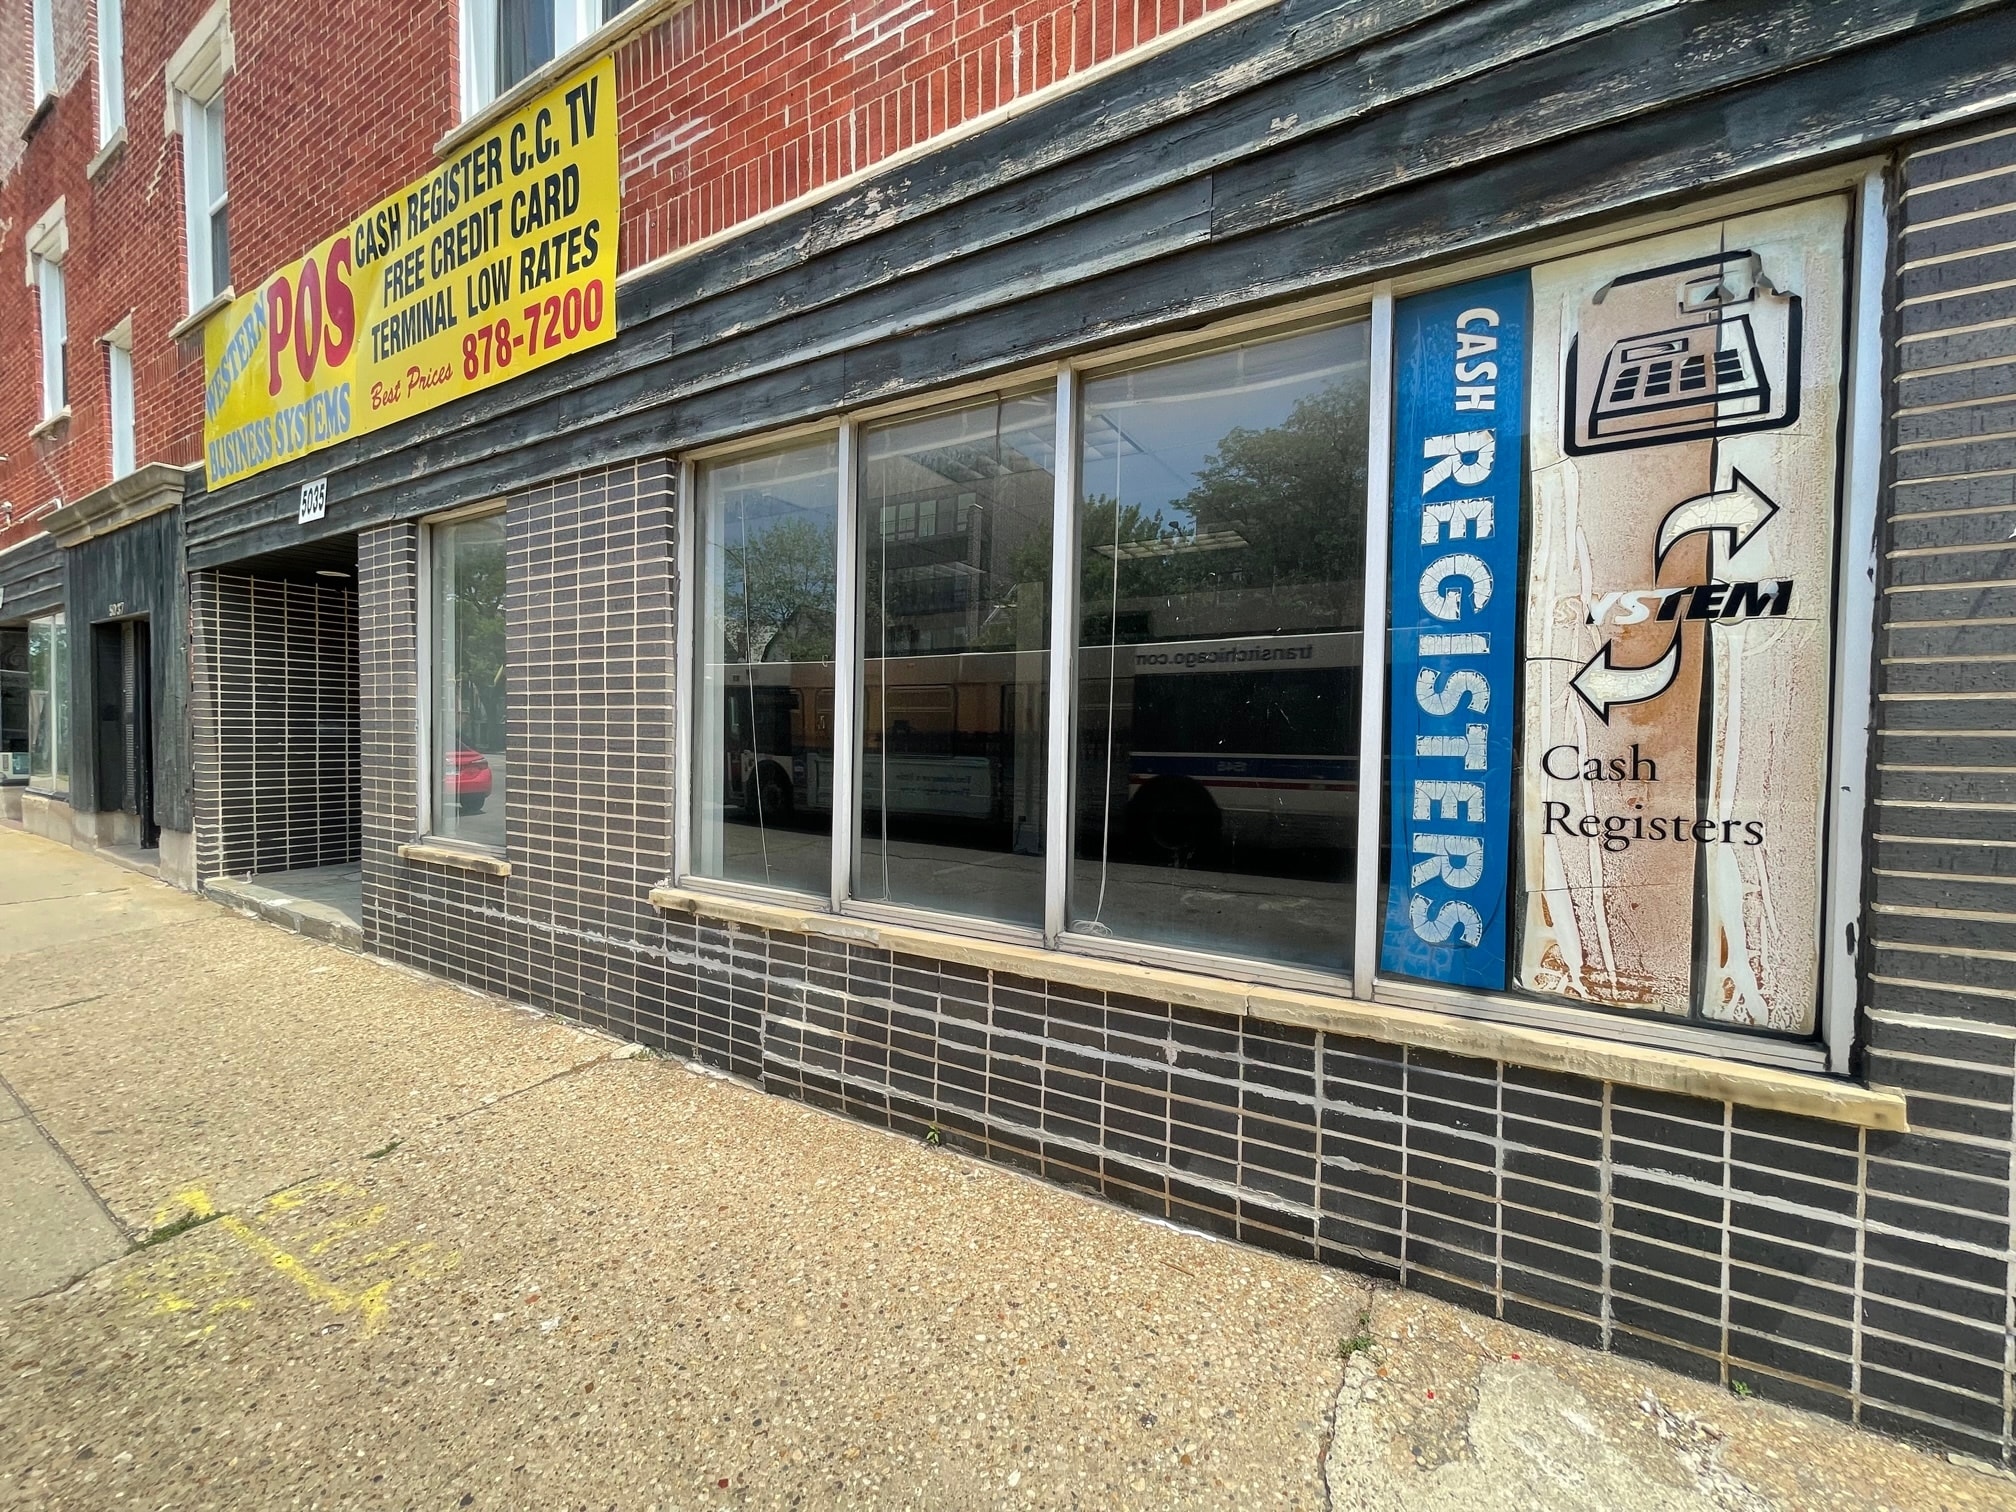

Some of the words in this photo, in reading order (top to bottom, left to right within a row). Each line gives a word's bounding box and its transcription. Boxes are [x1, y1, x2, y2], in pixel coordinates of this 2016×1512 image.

[355, 203, 401, 268] CASH
[407, 137, 503, 241] REGISTER
[510, 108, 560, 176] C.C.
[565, 75, 599, 147] TV
[384, 245, 425, 309] FREE
[431, 199, 503, 280] CREDIT
[511, 163, 580, 239] CARD
[205, 290, 268, 423] WESTERN
[267, 235, 356, 397] POS
[370, 380, 402, 411] Best
[406, 362, 453, 399] Prices
[462, 278, 604, 381] 878-7200
[371, 286, 458, 364] TERMINAL
[467, 256, 512, 319] LOW
[520, 219, 600, 294] RATES
[1453, 308, 1499, 412] CASH
[207, 415, 273, 483] BUSINESS
[274, 382, 351, 458] SYSTEMS
[302, 483, 325, 517] 5035
[1409, 427, 1496, 947] REGISTERS
[1541, 800, 1764, 852] Registers
[1542, 743, 1660, 782] Cash
